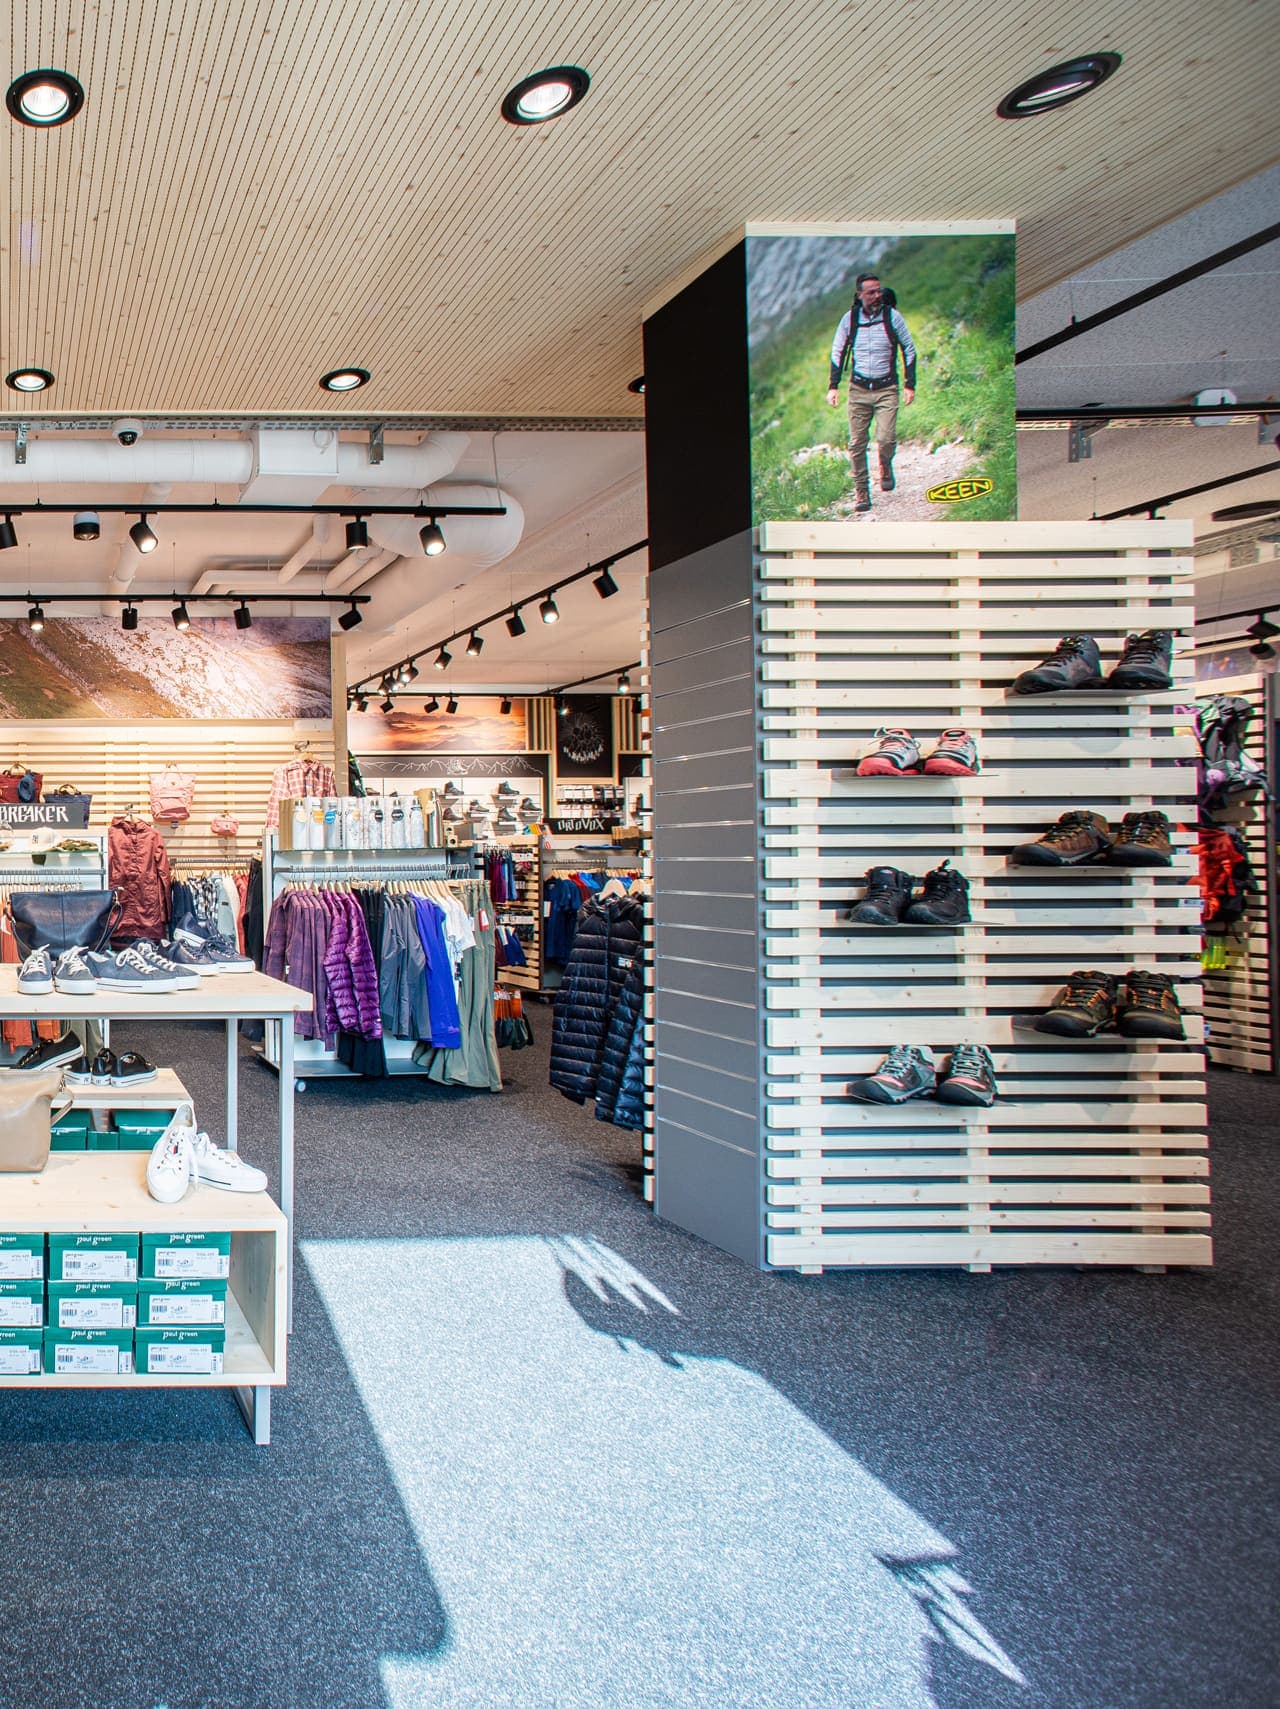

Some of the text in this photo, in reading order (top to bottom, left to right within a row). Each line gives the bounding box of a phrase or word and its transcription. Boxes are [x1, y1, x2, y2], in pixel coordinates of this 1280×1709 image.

[929, 481, 989, 500] KEEN
[557, 818, 605, 832] ORTOVOX
[76, 1235, 112, 1246] paul green
[169, 1233, 205, 1244] paul green
[75, 1283, 111, 1293] paul green
[165, 1281, 200, 1291] paul green
[71, 1330, 107, 1340] paul green
[162, 1330, 198, 1340] paul green
